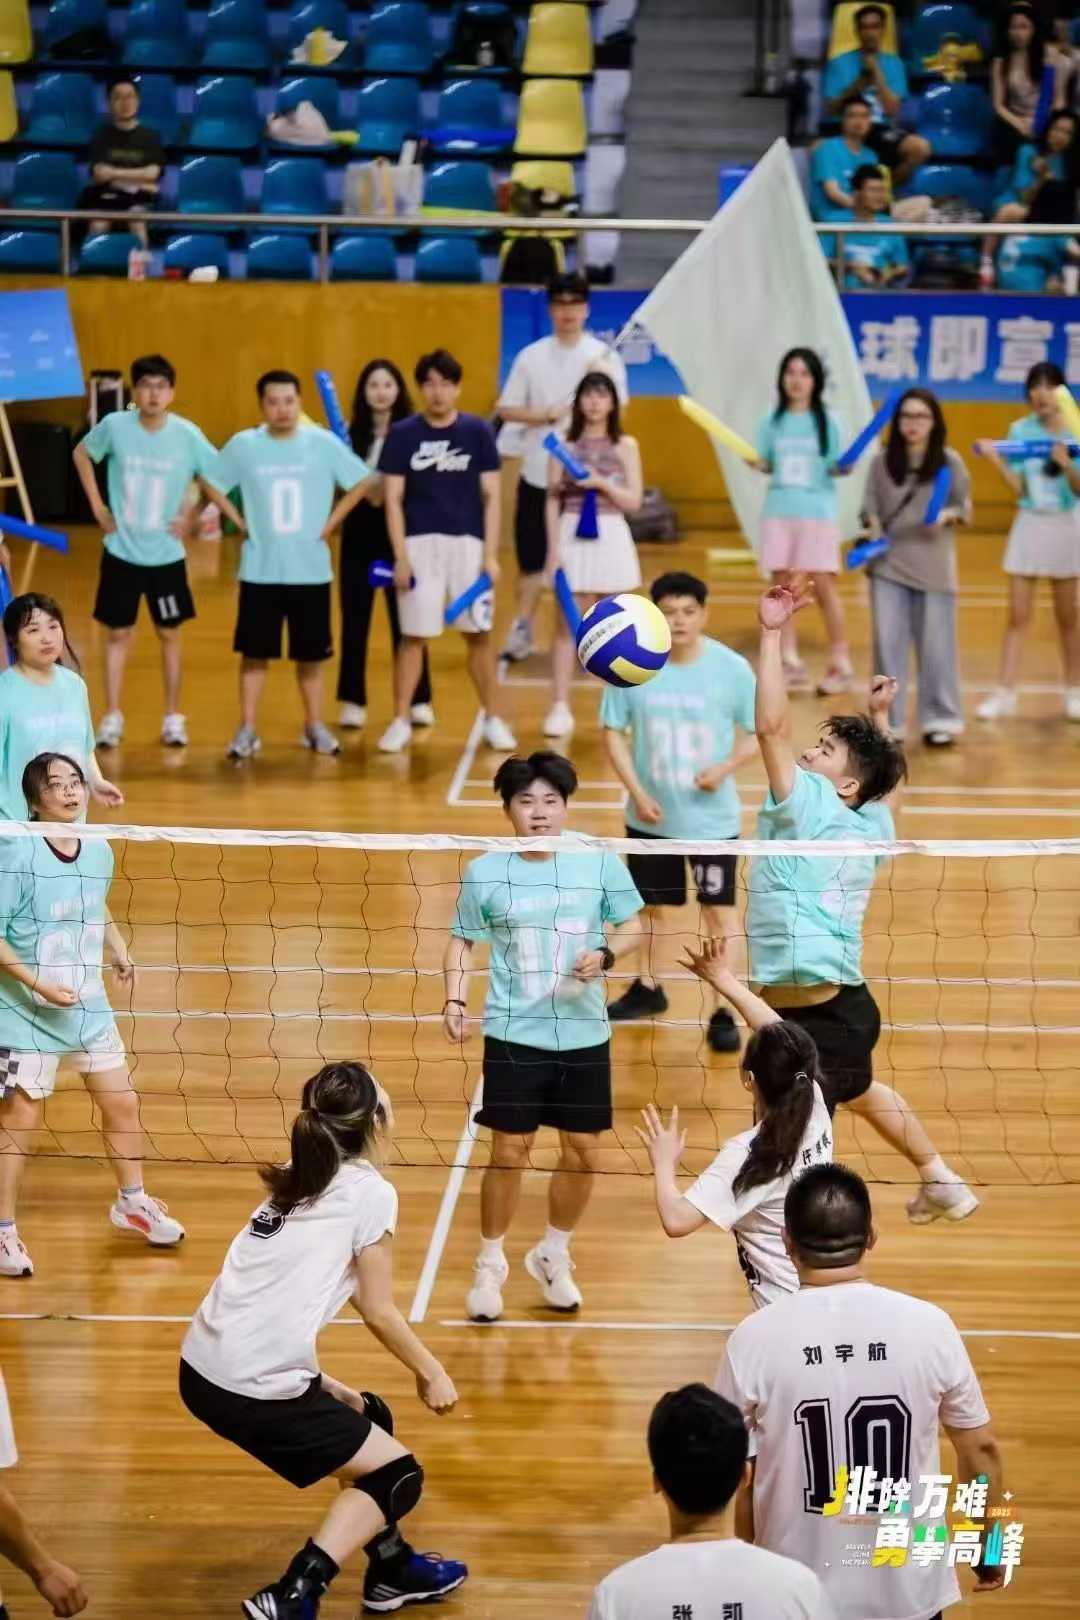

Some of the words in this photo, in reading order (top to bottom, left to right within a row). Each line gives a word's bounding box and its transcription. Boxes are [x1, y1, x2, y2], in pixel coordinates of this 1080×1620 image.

[860, 315, 1080, 382] 球即宣
[271, 478, 304, 534] 0
[157, 595, 180, 619] 11
[803, 1342, 887, 1365] 刘宇航
[794, 1394, 913, 1514] 10
